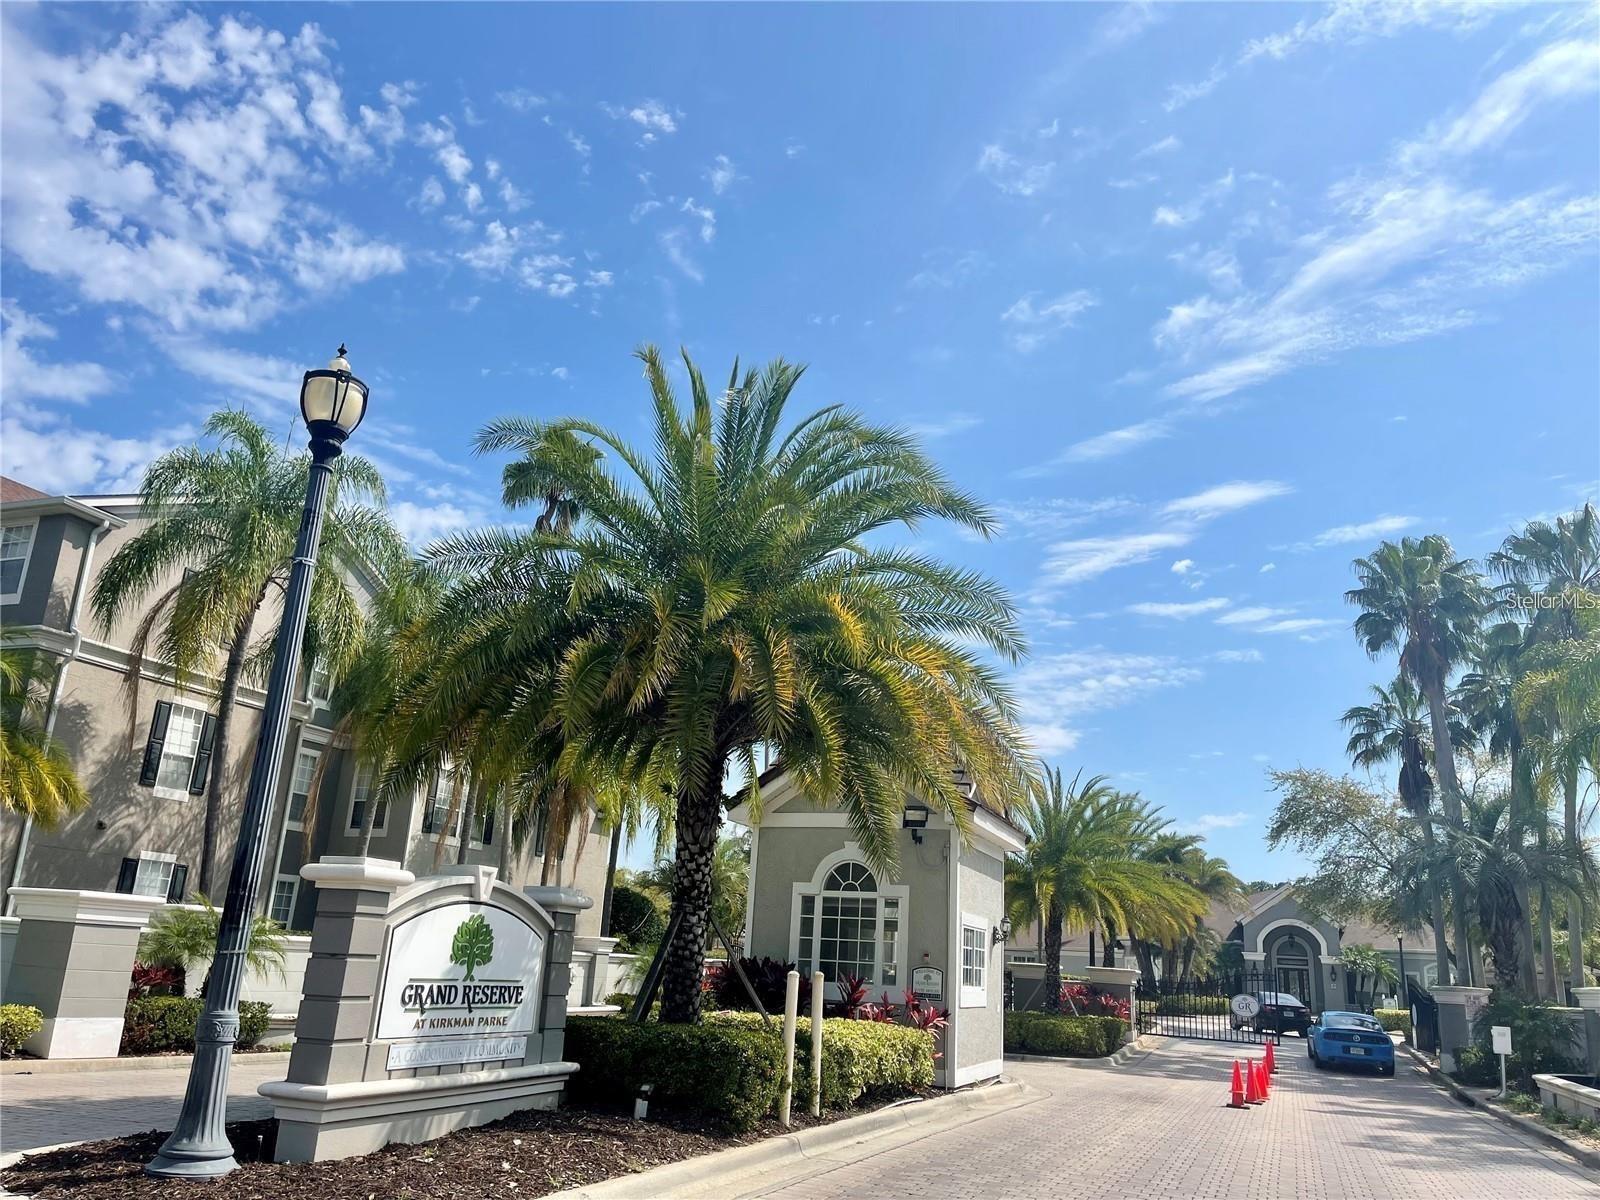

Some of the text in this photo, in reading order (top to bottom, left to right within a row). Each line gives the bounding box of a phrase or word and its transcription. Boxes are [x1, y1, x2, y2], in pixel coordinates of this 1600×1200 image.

[401, 985, 523, 1015] GRAND RESERVE
[1238, 1002, 1253, 1014] GR
[413, 1016, 508, 1031] AT KIRKMAN PARKE
